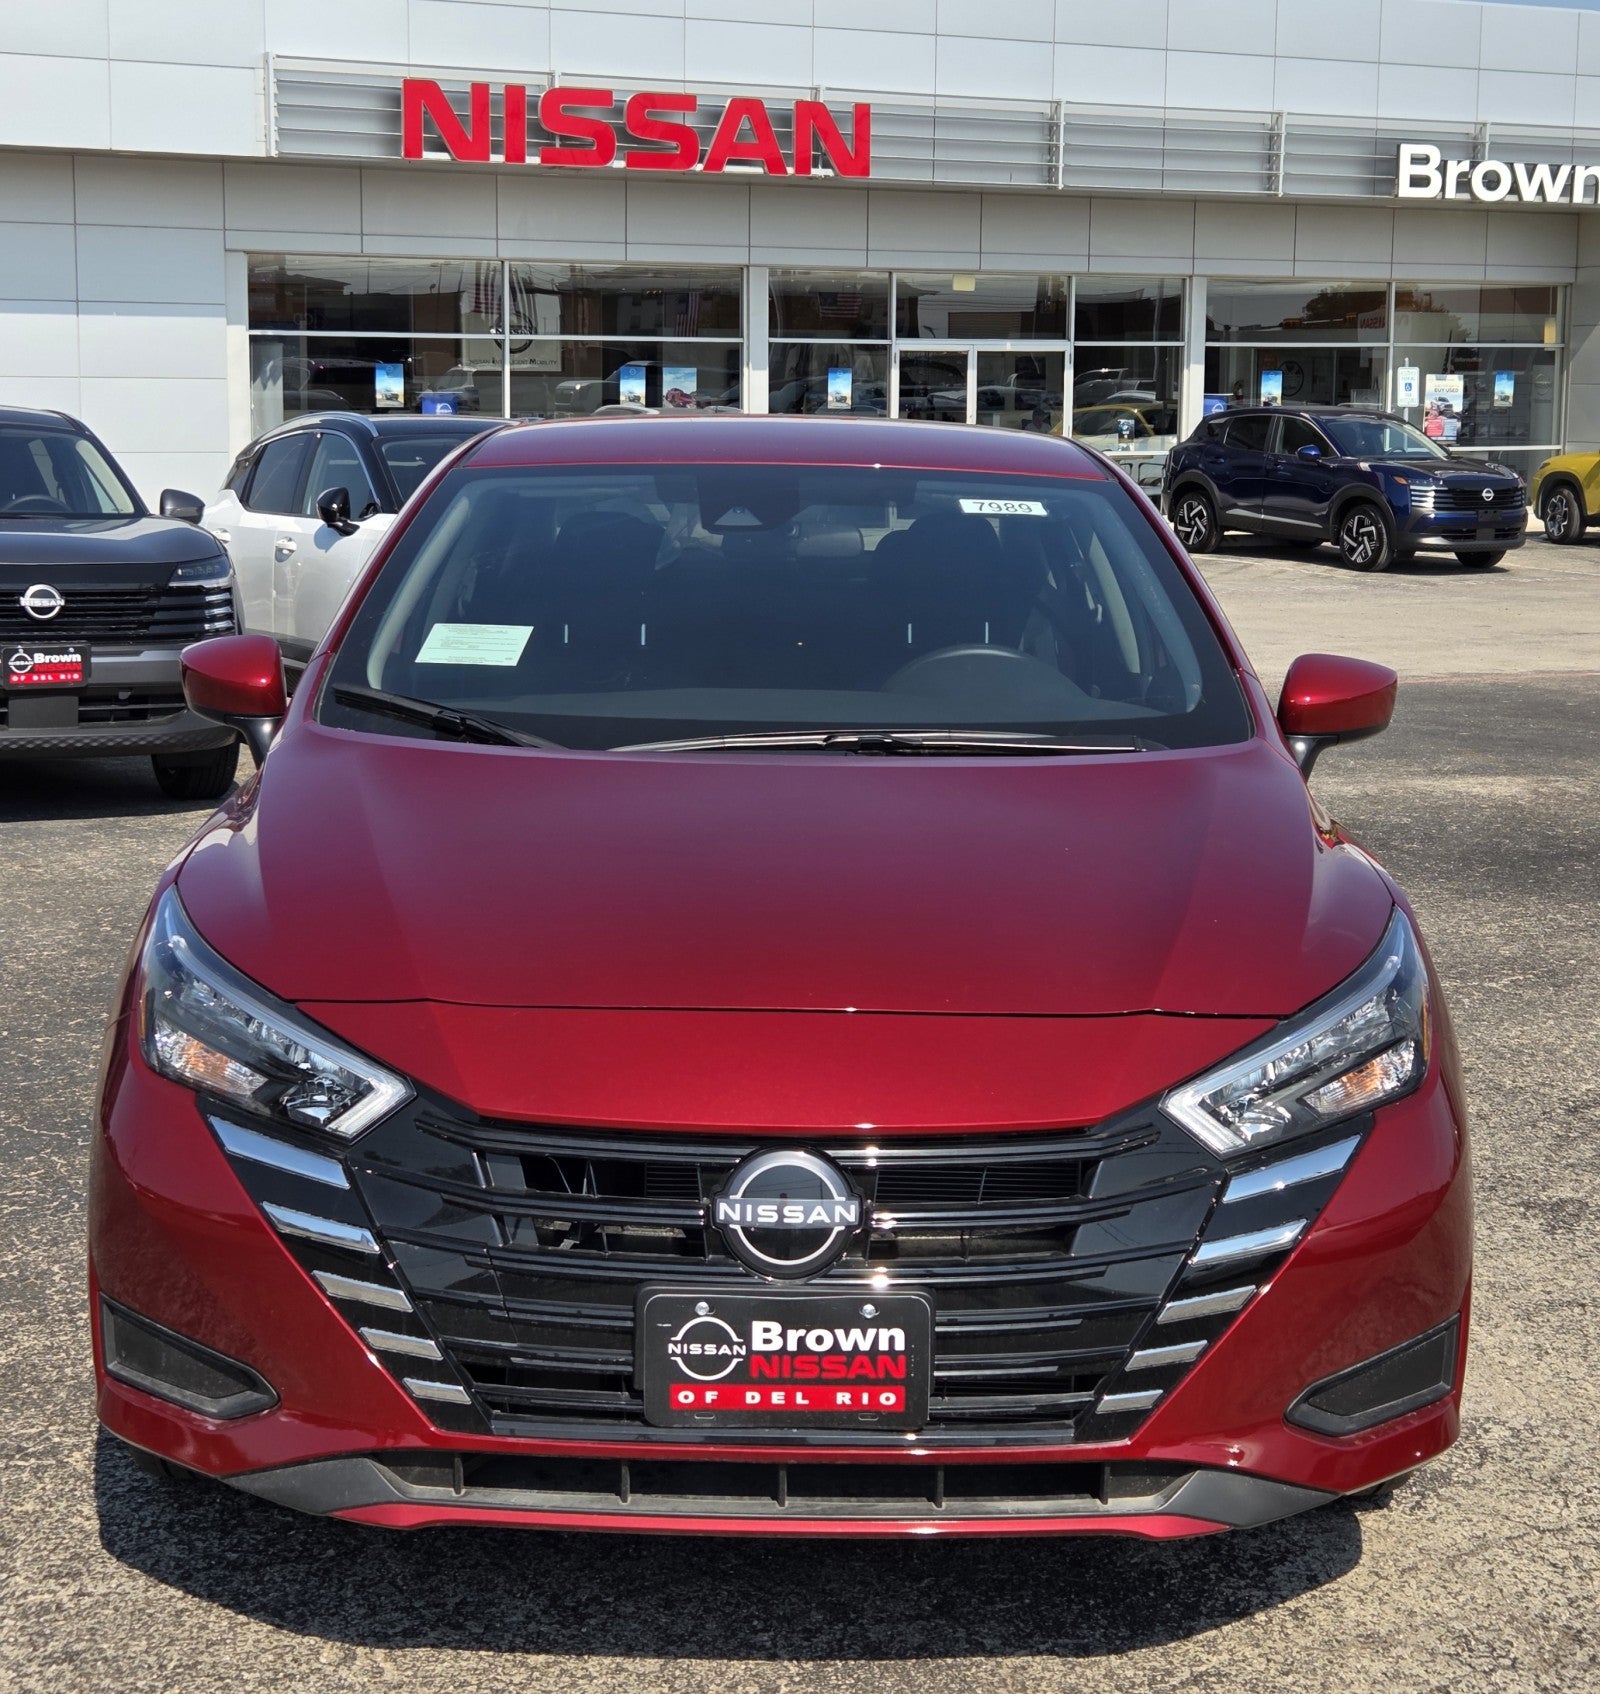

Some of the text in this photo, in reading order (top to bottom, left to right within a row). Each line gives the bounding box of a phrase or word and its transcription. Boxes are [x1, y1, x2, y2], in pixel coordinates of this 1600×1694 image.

[402, 78, 871, 178] NISSAN
[1398, 143, 1600, 204] Brown
[972, 501, 1033, 513] 7989
[20, 597, 65, 607] NISSAN
[33, 653, 82, 663] Brown
[34, 664, 82, 672] NISSAN
[718, 1202, 857, 1224] NISSAN
[667, 1320, 906, 1356] NISSAN Brown
[751, 1355, 906, 1379] NISSAN
[677, 1390, 897, 1405] OF DEL RIO
